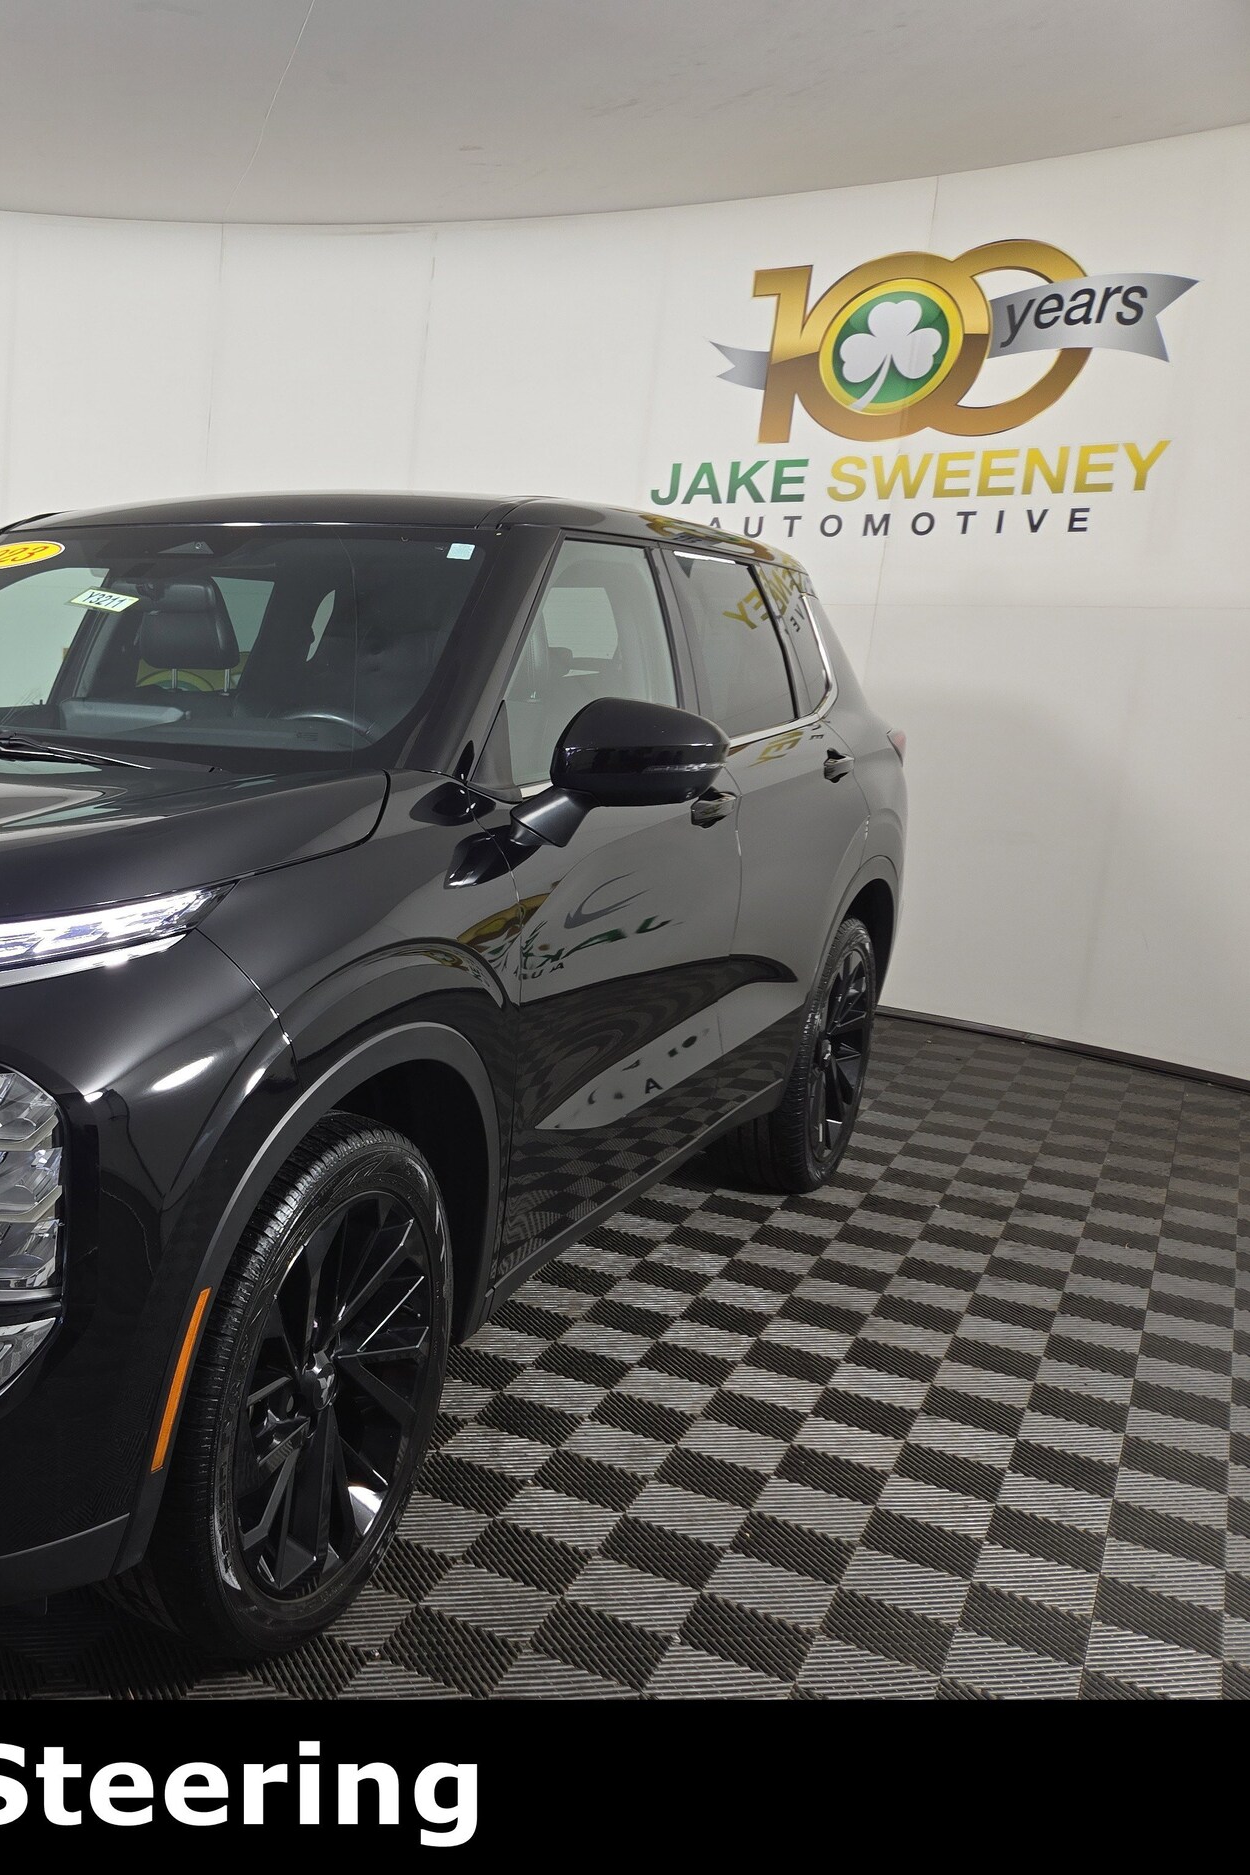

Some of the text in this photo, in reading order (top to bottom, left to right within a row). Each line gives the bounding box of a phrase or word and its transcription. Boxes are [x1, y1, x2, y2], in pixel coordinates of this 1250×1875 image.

[753, 239, 1149, 444] 100 years
[651, 440, 1171, 505] JAKE SWEENEY
[83, 592, 127, 608] Y3211
